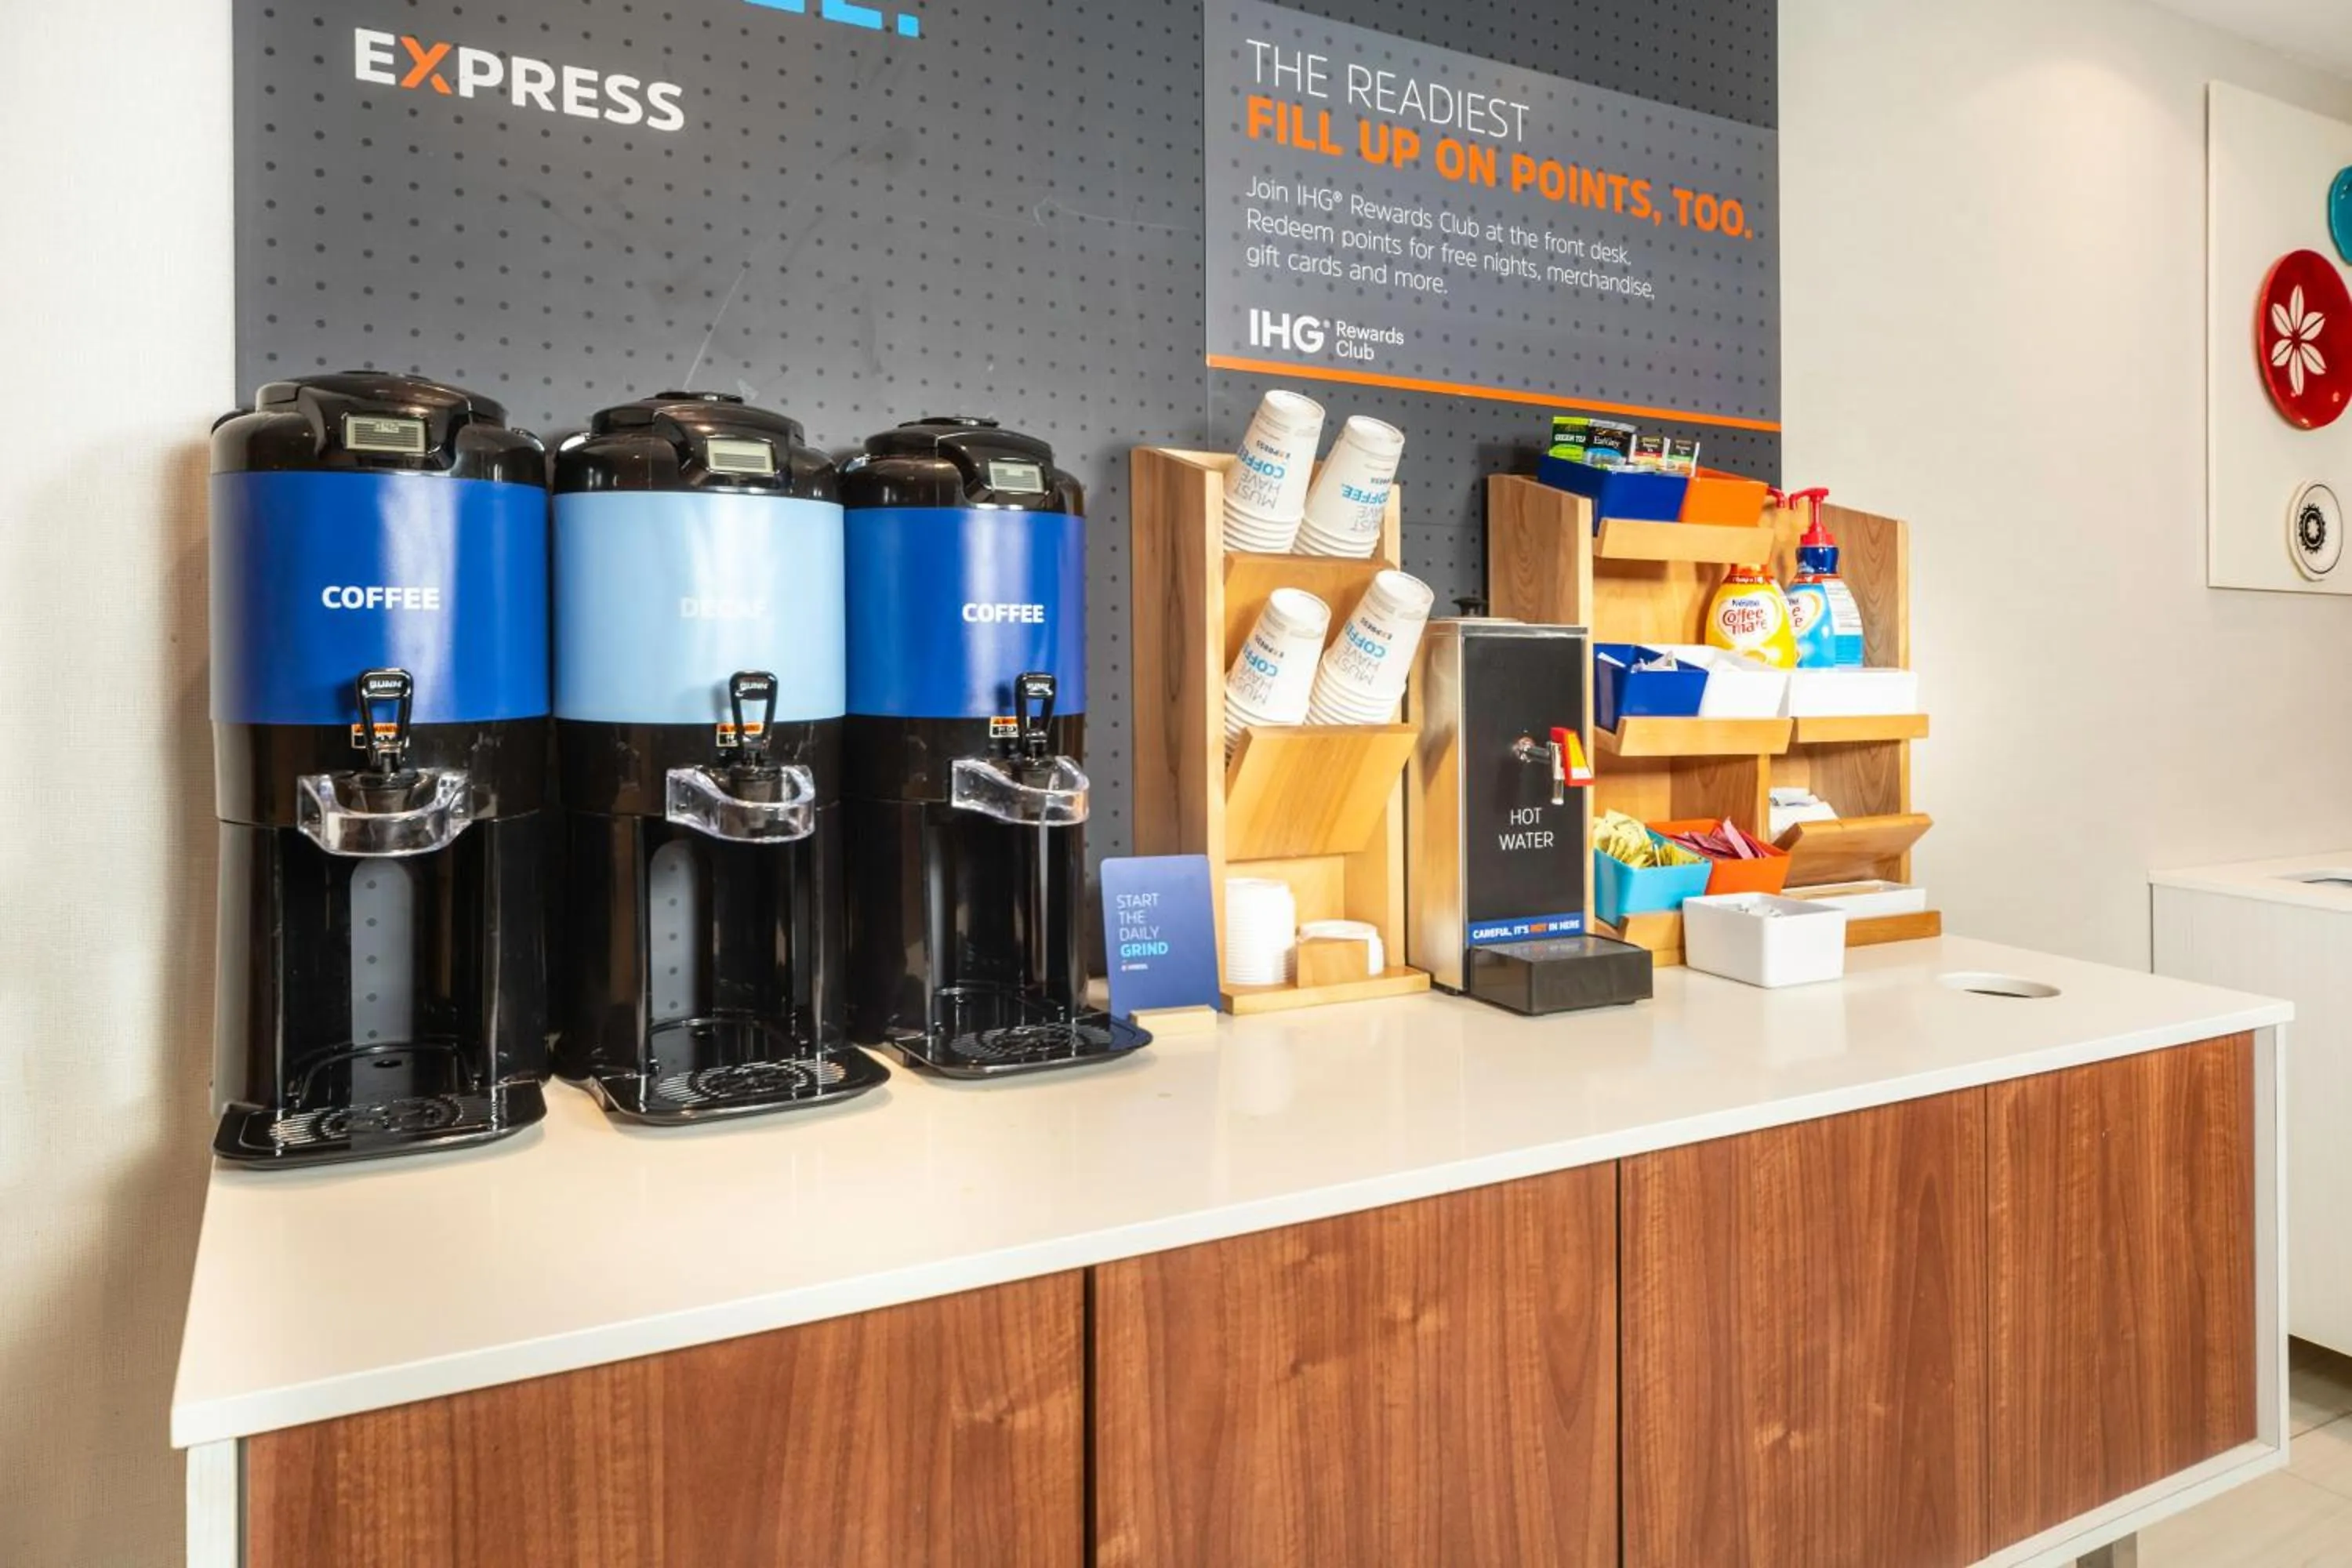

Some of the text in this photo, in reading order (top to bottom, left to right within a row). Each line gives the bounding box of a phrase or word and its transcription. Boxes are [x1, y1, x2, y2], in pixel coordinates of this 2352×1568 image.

[354, 27, 684, 132] EXPRESS
[1246, 38, 1530, 143] THE READIEST
[1247, 94, 1754, 241] FILL UP ON POINTS, TOO.
[1246, 176, 1289, 203] Join
[1350, 194, 1433, 230] Rewards
[1439, 211, 1480, 238] Club
[1486, 223, 1504, 244] at
[1509, 225, 1539, 249] the
[1544, 231, 1585, 258] front
[1590, 241, 1632, 267] desk.
[1247, 208, 1656, 301] Redeem points for free nights, merchandise,
[1246, 245, 1449, 295] gift cards and more.
[1335, 319, 1406, 345] Rewards
[1335, 339, 1375, 361] Club
[321, 585, 441, 611] COFFEE
[961, 602, 1046, 623] COFFEE
[369, 680, 402, 689] BUNN
[1510, 807, 1543, 826] HOT
[1498, 831, 1555, 851] WATER
[1116, 892, 1160, 909] START
[1118, 910, 1146, 925] THE
[1120, 926, 1160, 942] DAILY
[1120, 942, 1169, 958] GRIND
